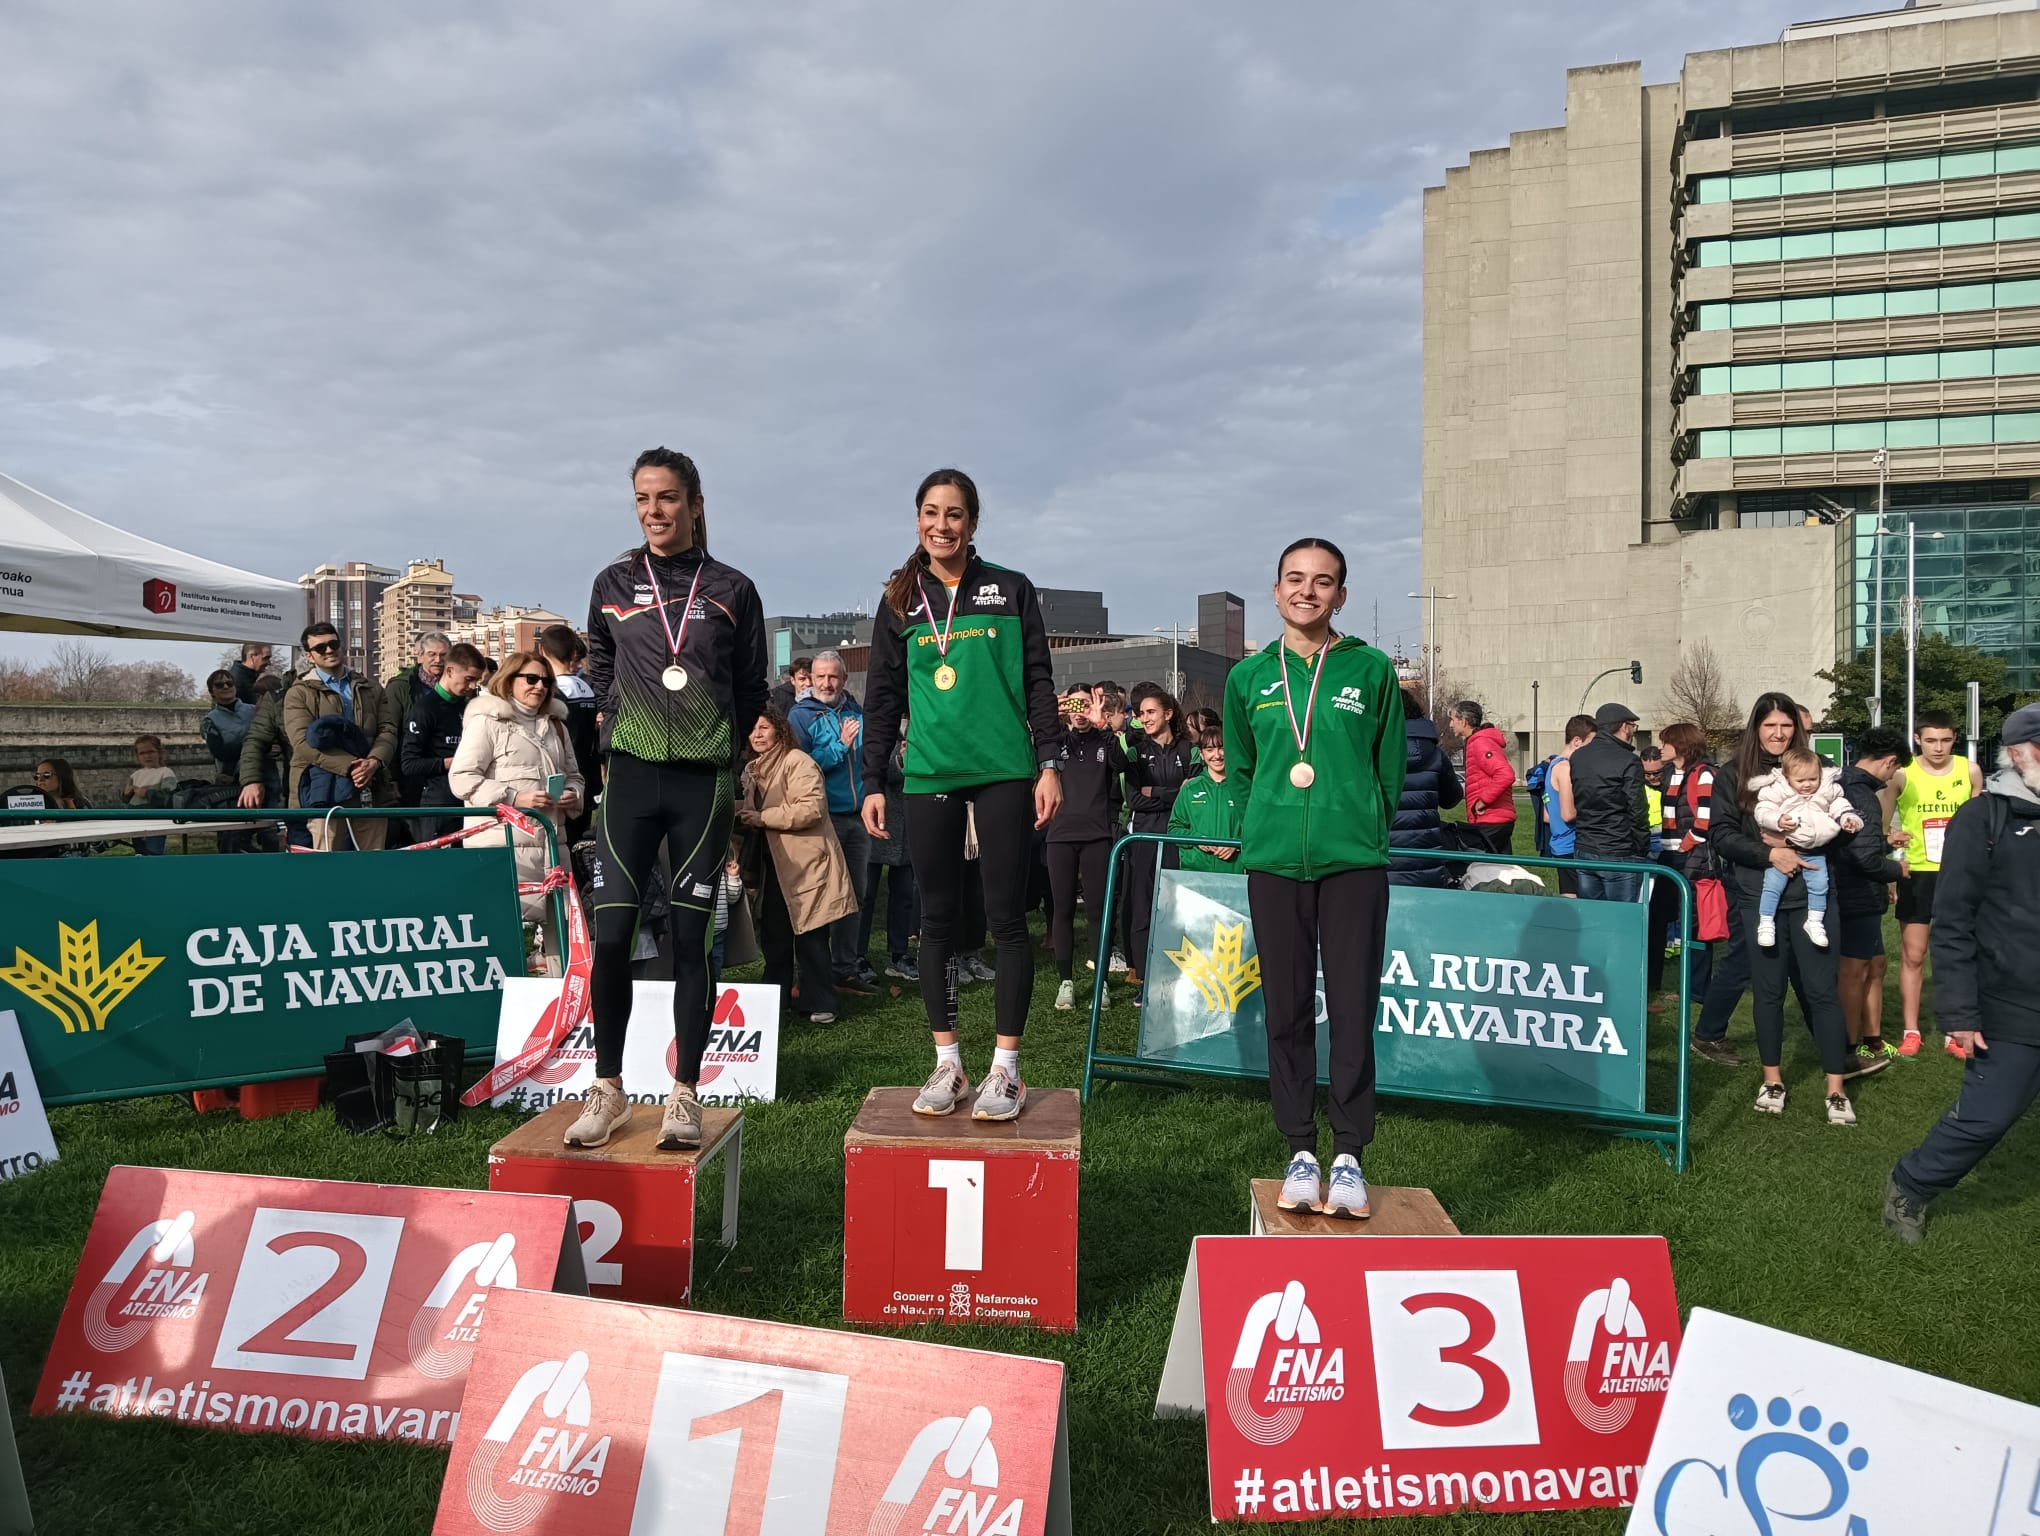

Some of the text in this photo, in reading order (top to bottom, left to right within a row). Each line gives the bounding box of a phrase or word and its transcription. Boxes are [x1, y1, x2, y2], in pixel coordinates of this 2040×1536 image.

[181, 592, 210, 601] Instituto
[211, 595, 237, 605] Navarro
[250, 601, 276, 609] Deporte
[181, 603, 219, 613] Nafarroako
[980, 584, 999, 595] PA
[1341, 686, 1362, 700] PA
[186, 914, 489, 967] CAJA RURAL
[188, 956, 506, 1017] DE NAVARRA
[1428, 953, 1604, 1004] RURAL
[558, 1026, 596, 1049] FN
[705, 1030, 762, 1053] FNA
[1378, 996, 1629, 1056] NAVARRA
[551, 1049, 598, 1060] ATLETIS
[700, 1052, 759, 1063] TLETISMO
[928, 1159, 985, 1271] 1
[574, 1200, 623, 1286] 2
[129, 1269, 210, 1306] FNA
[238, 1231, 368, 1361] 2
[975, 1293, 1039, 1305] Nafarroako
[119, 1302, 197, 1319] ATLETISMO
[883, 1304, 898, 1314] de
[975, 1307, 1031, 1318] Gobernua
[1269, 1348, 1345, 1386] FNA
[1400, 1292, 1511, 1428] 3
[1602, 1341, 1671, 1378] FNA
[1264, 1386, 1345, 1403] ATLETISMO
[1598, 1377, 1672, 1394] ATLETISMO
[56, 1370, 461, 1442] #atletismonavarr
[518, 1426, 612, 1478] FNA
[688, 1388, 785, 1536] 1
[507, 1468, 600, 1497] ATLETISMO
[1234, 1464, 1646, 1515] #atletismonavarr
[922, 1487, 1024, 1536] FNA
